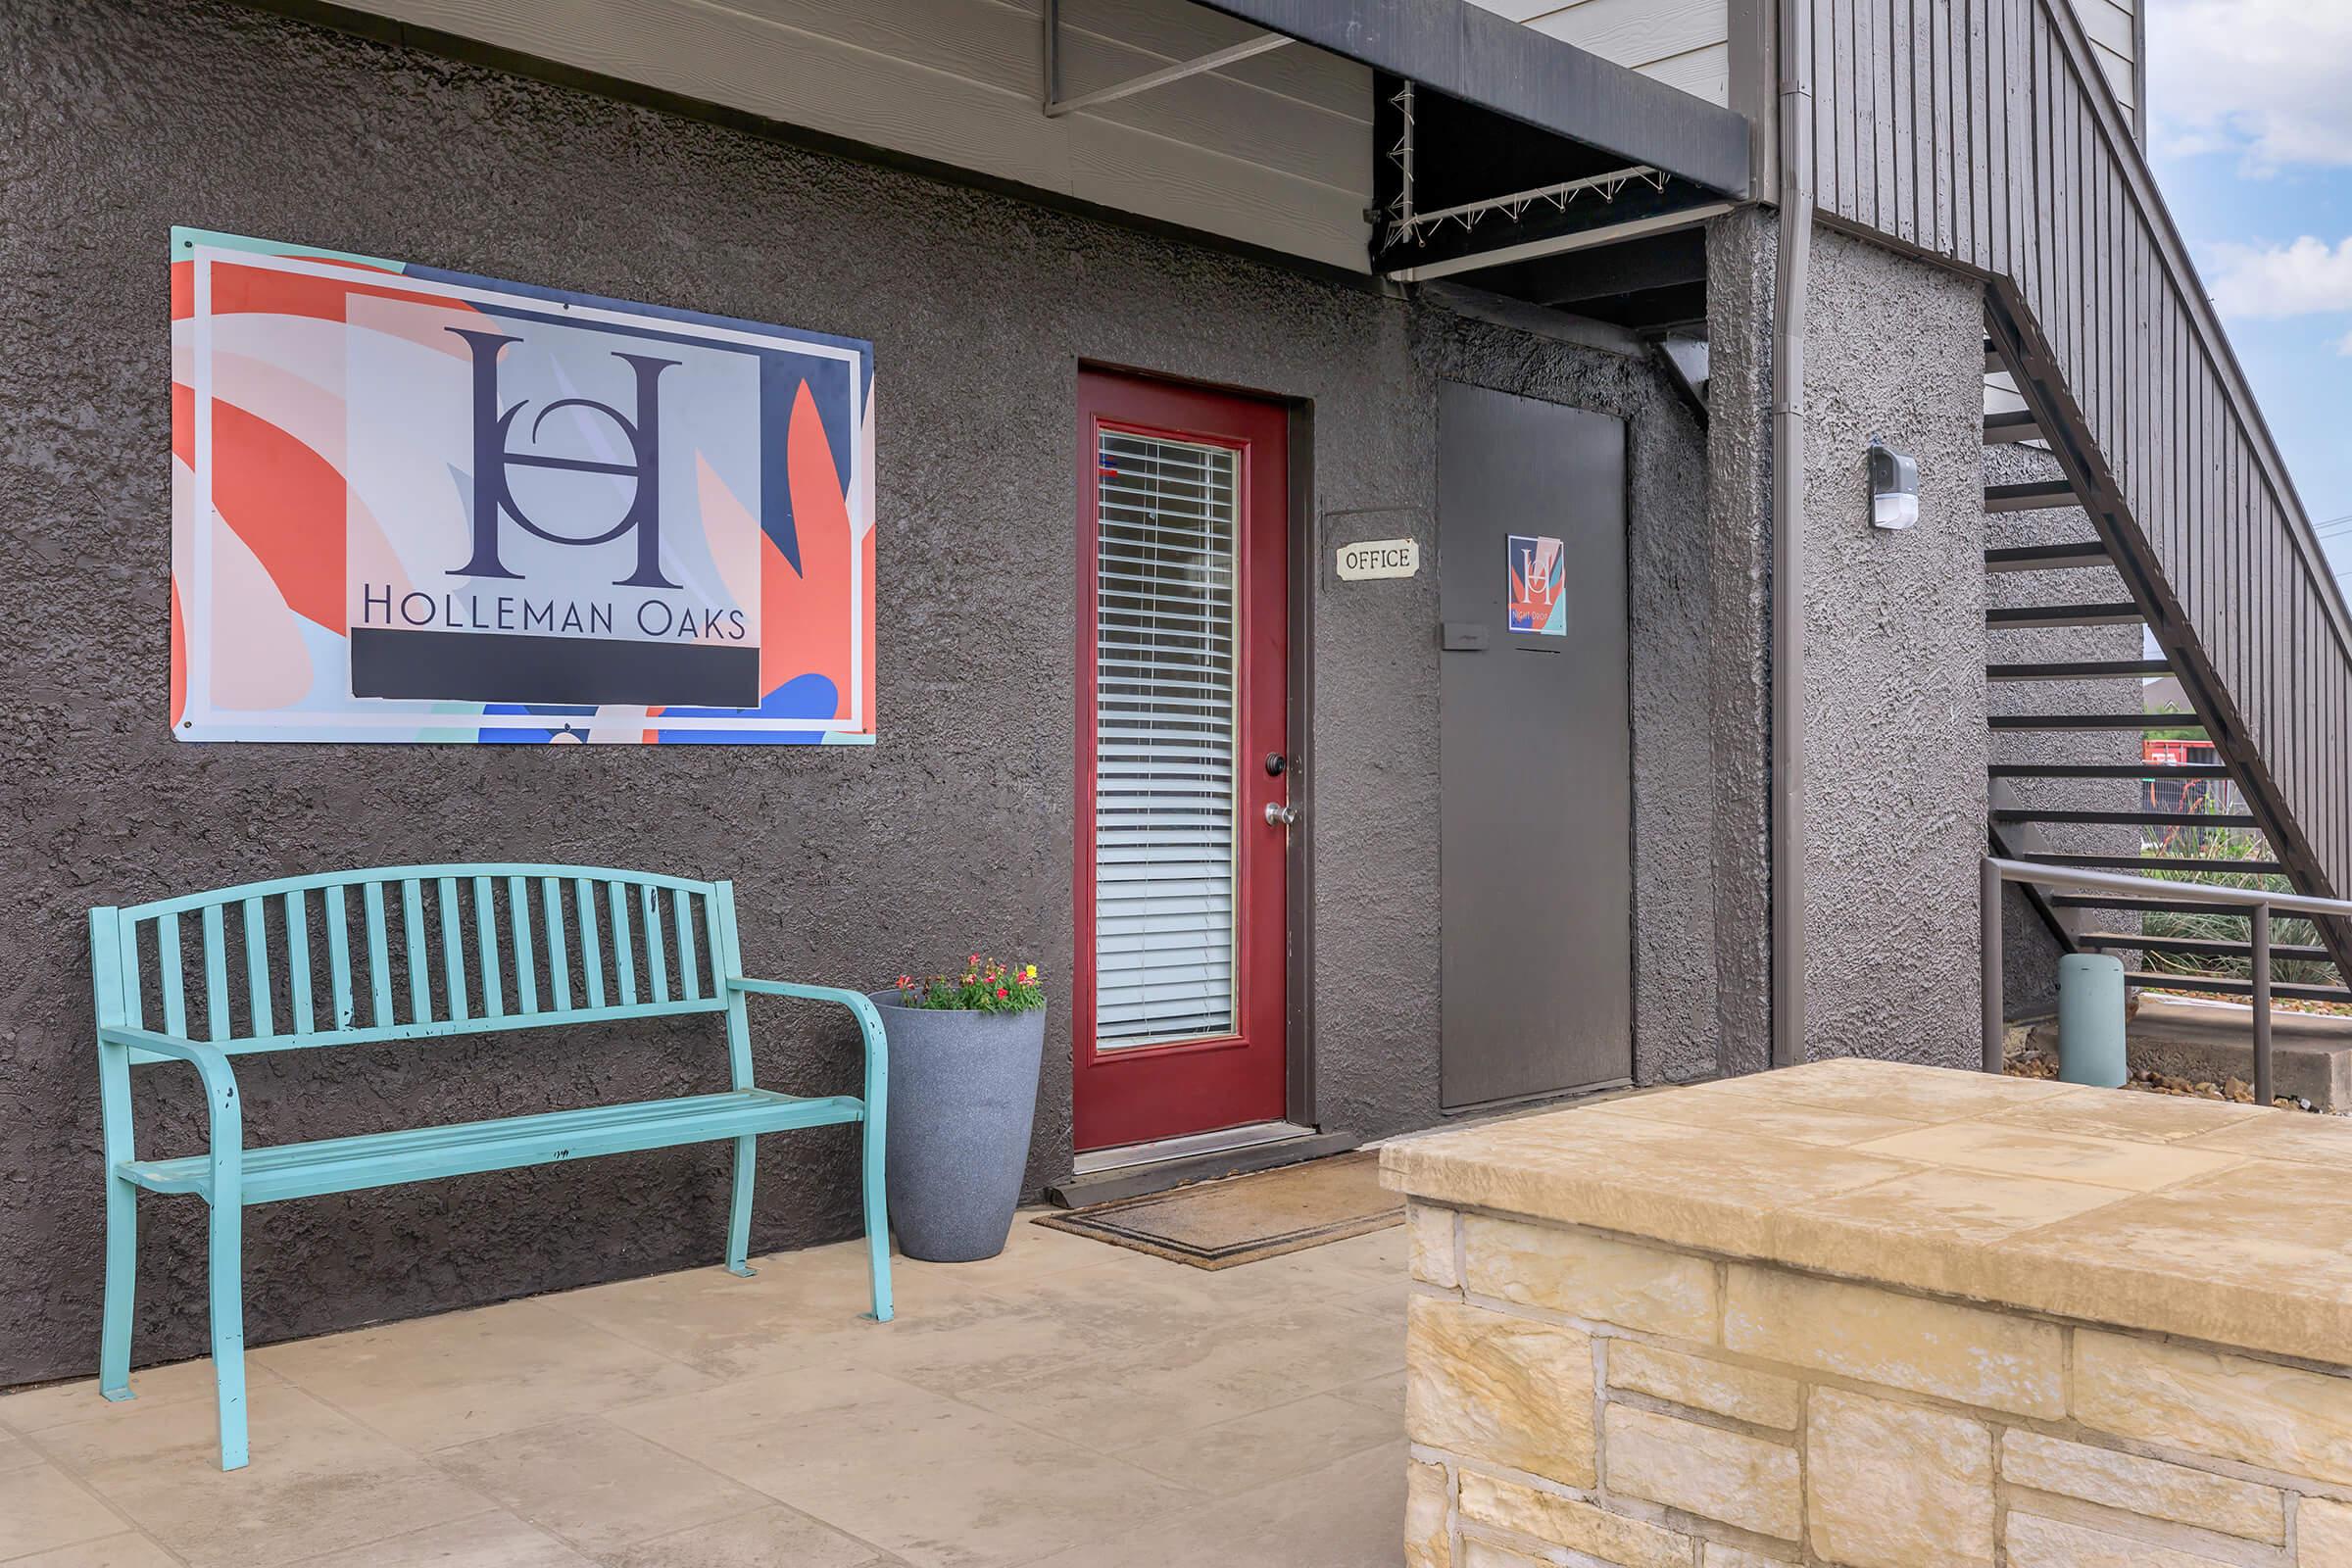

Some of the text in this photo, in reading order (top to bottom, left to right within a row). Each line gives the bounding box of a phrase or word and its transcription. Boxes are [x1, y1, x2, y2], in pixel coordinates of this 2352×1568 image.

[1346, 548, 1410, 569] OFFICE
[365, 583, 746, 641] HOLLEMAN OAKS
